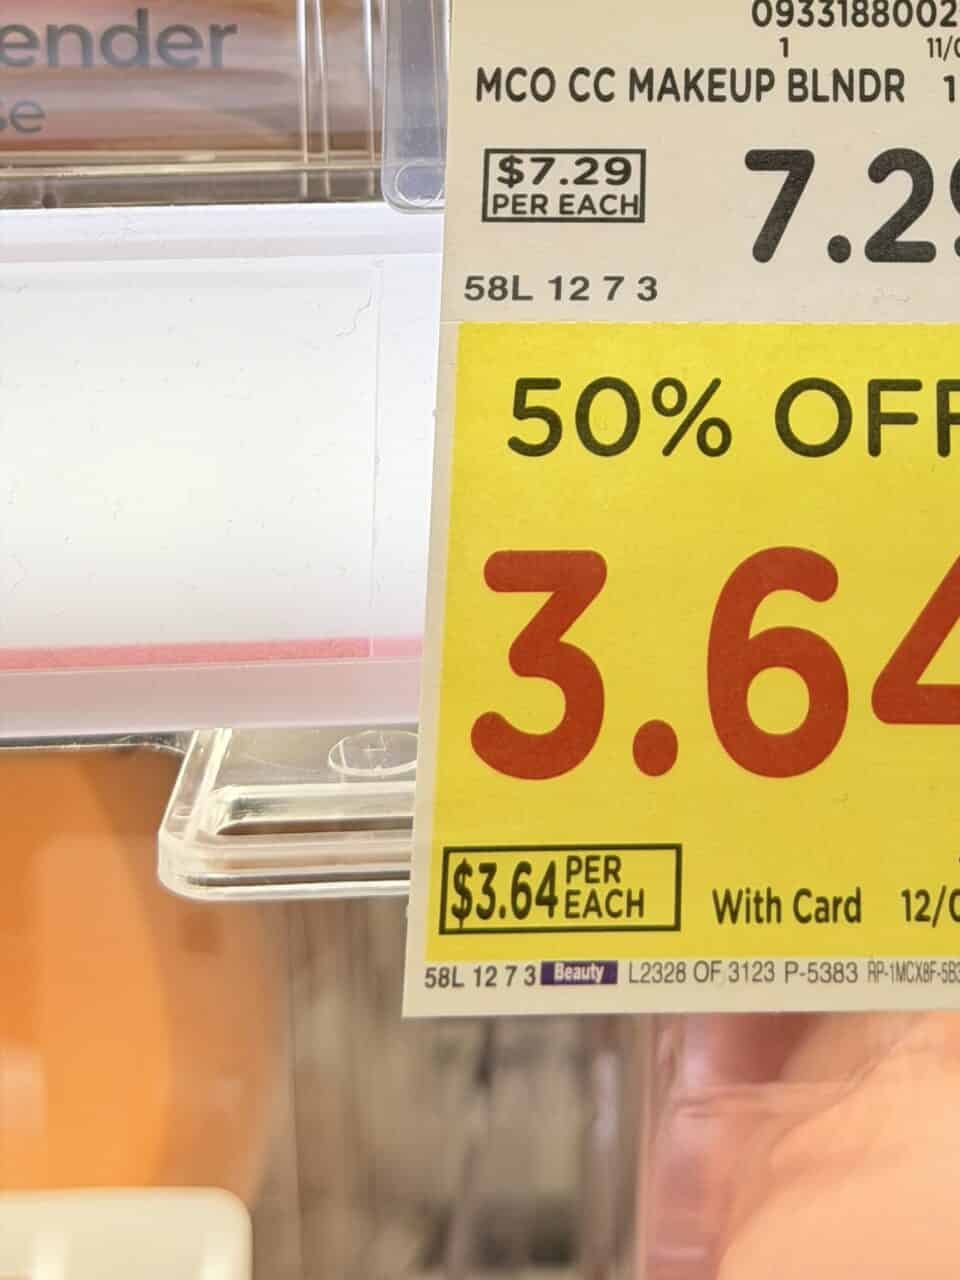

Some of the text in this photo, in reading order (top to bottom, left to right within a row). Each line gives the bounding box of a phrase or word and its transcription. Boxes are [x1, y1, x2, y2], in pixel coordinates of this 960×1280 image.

[779, 36, 790, 59] 1
[475, 66, 557, 104] MCO
[567, 66, 617, 104] CC
[627, 66, 777, 104] MAKEUP
[786, 66, 907, 104] BLNDR
[942, 74, 957, 104] 1
[495, 154, 634, 188] $7.29
[492, 192, 638, 217] PER EACH
[463, 274, 659, 303] 58L 12 7 3
[507, 376, 733, 458] 50%
[564, 854, 622, 884] PER
[451, 858, 559, 929] $3.64
[563, 888, 646, 921] EACH
[711, 885, 863, 926] With Card
[424, 965, 537, 989] 58L 12 7 3
[553, 963, 605, 983] Beauty
[628, 960, 688, 985] L2328
[693, 959, 724, 984] OF
[727, 960, 776, 984] 3123
[783, 960, 860, 985] P-5383
